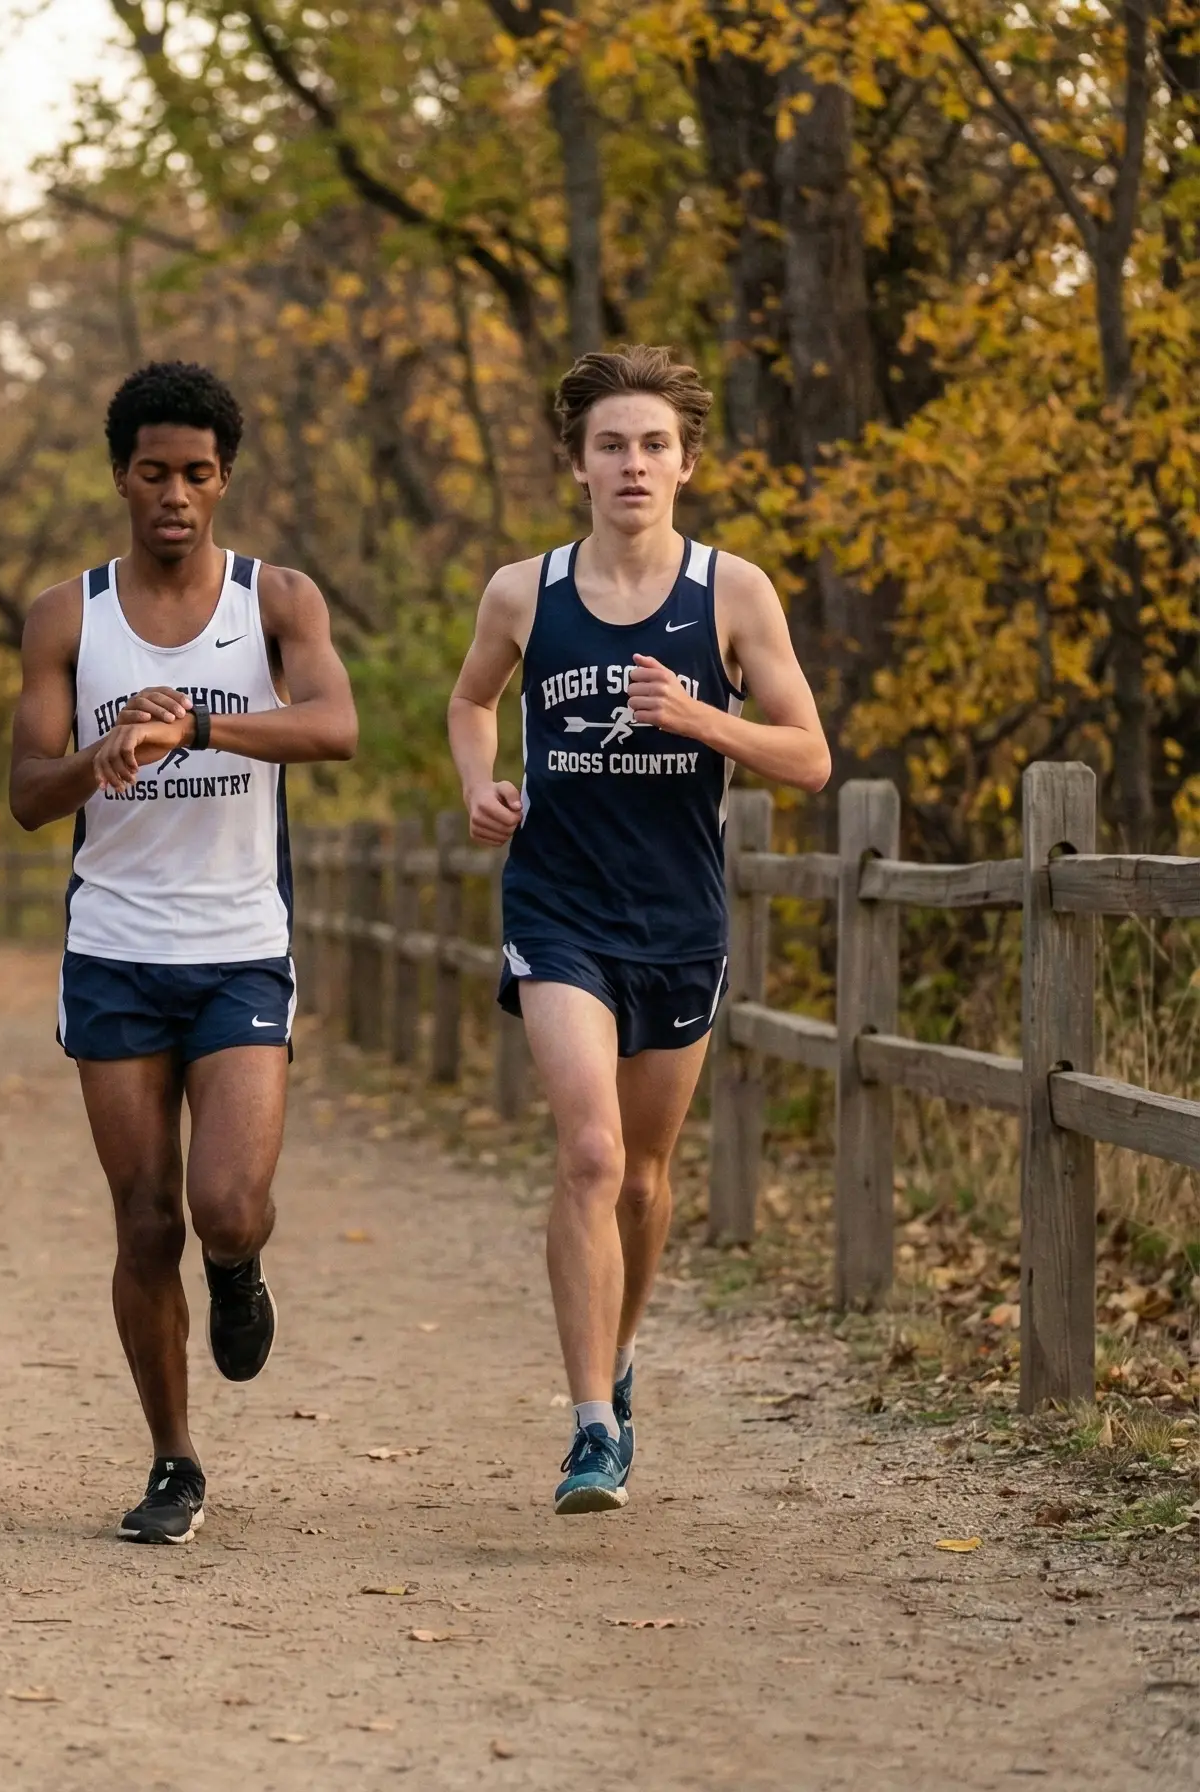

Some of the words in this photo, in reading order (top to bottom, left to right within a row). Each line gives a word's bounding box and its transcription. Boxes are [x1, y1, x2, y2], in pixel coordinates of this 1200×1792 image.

[541, 665, 598, 710] HIGH
[94, 692, 138, 737] HI
[175, 687, 249, 715] HOO
[548, 750, 604, 774] CROSS
[609, 752, 699, 775] COUNTRY
[164, 773, 251, 799] COUNTRY
